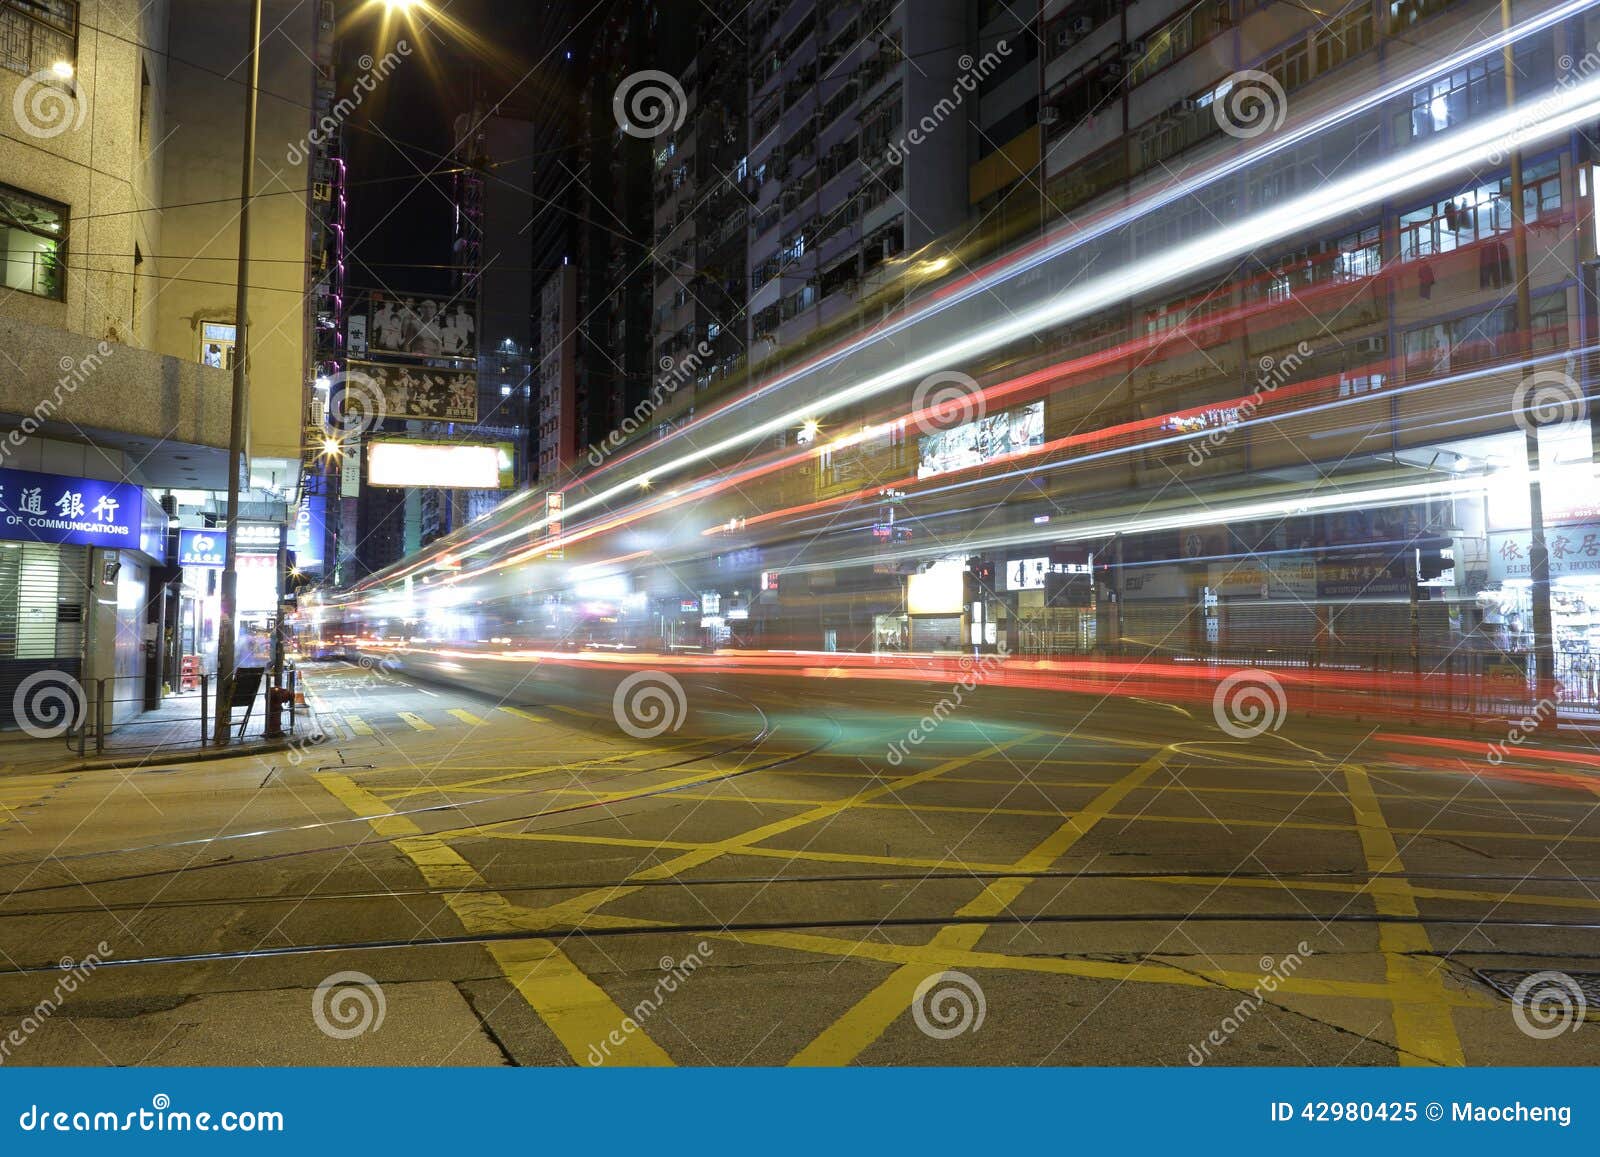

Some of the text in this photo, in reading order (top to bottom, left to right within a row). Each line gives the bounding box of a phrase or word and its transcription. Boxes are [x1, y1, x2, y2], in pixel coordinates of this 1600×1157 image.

[6, 515, 129, 536] OF COMMUNICATIONS
[1499, 533, 1600, 561] 依家居
